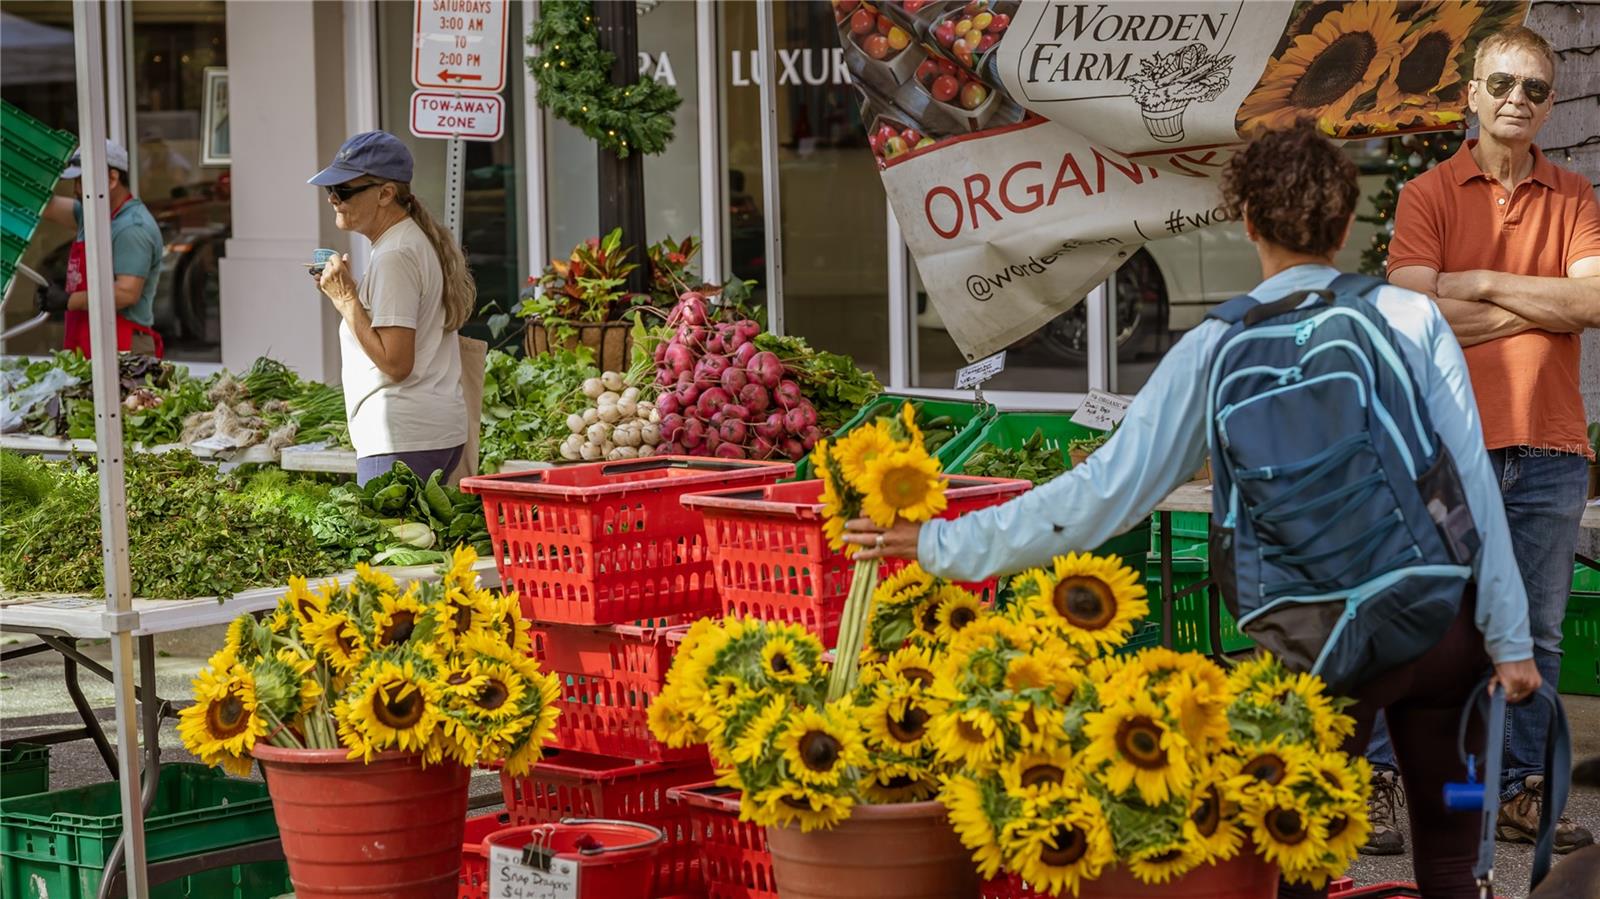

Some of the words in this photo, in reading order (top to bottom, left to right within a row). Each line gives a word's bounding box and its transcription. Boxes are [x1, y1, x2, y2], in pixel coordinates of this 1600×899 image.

[433, 0, 491, 14] SATURDAYS
[439, 17, 464, 31] 3:00
[468, 18, 484, 31] AM
[1053, 4, 1229, 42] WORDEN
[455, 35, 467, 49] TO
[439, 52, 463, 66] 2:00
[466, 53, 481, 67] PM
[1026, 43, 1134, 84] FARM
[421, 99, 496, 114] TOW-AWAY
[437, 115, 477, 129] ZONE
[501, 866, 529, 886] Snap
